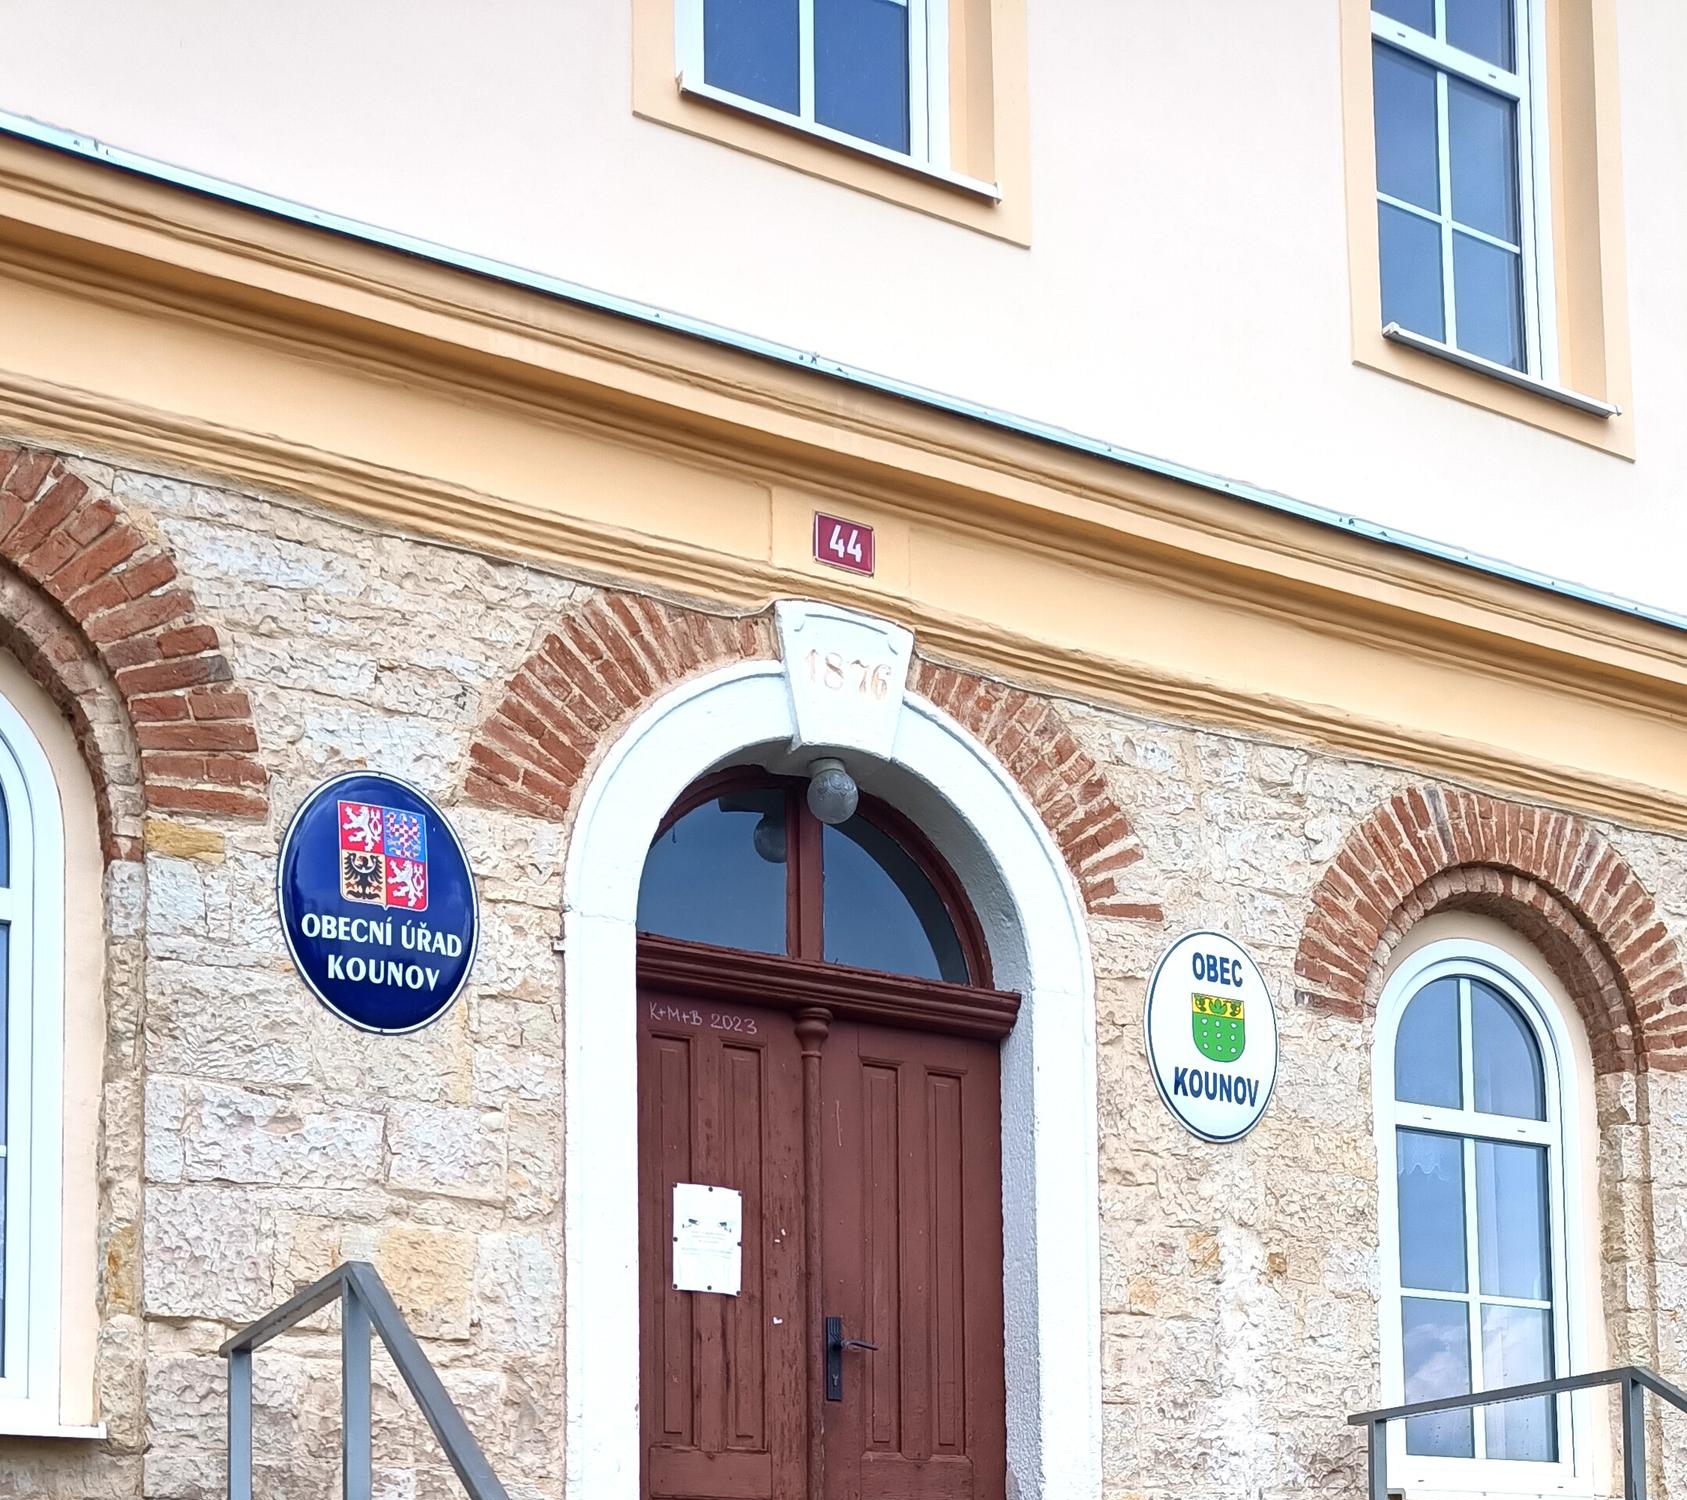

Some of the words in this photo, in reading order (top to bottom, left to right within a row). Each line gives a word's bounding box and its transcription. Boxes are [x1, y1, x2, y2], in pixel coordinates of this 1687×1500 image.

[829, 524, 863, 563] 44
[805, 649, 892, 700] 1876
[301, 913, 393, 946] OBECNÍ
[401, 919, 463, 958] ÚŘAD
[327, 954, 440, 992] KOUNOV
[1192, 951, 1243, 987] OBEC
[650, 1002, 703, 1026] K+M+B
[710, 1013, 758, 1035] 2023
[1173, 1066, 1259, 1107] KOUNOV
